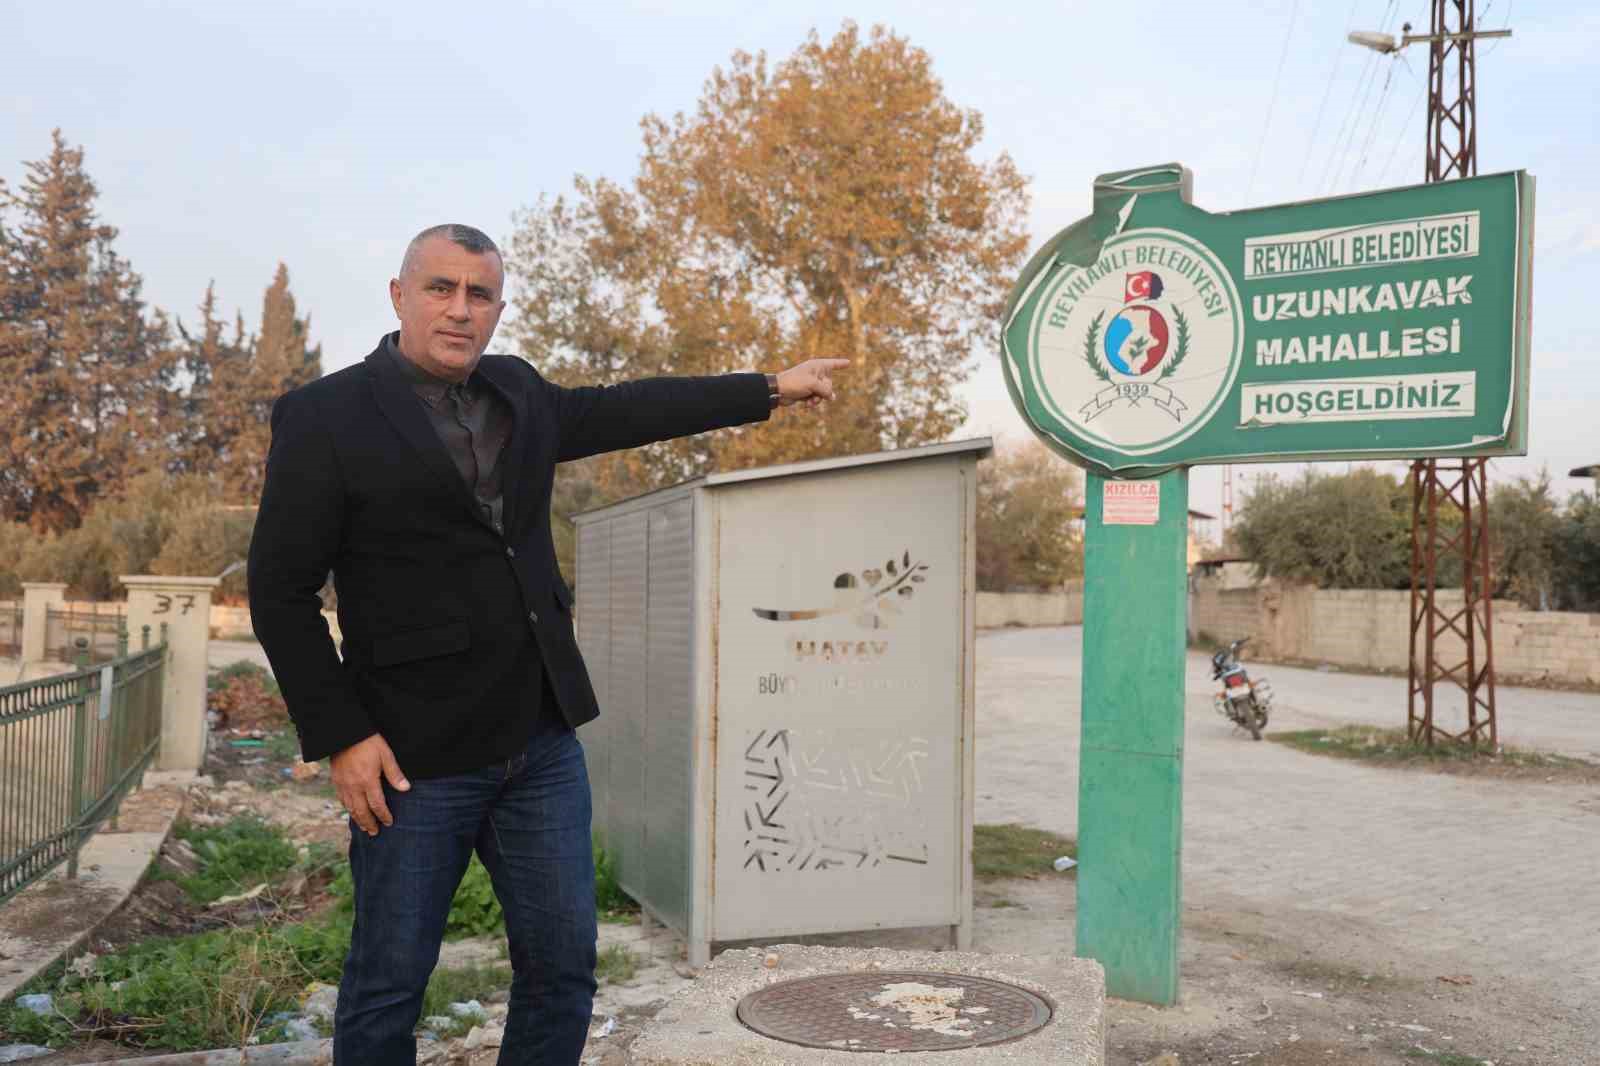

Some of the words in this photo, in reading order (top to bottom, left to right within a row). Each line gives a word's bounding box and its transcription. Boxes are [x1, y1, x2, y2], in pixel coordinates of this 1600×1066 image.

[1253, 237, 1346, 275] REYHANLI
[1352, 215, 1469, 264] BELEDİYESİ
[1135, 245, 1229, 318] BELEDİYESİ
[1252, 274, 1473, 322] UZUNKAVAK
[1255, 317, 1461, 366] MAHALLESİ
[1116, 384, 1150, 398] 1939
[1254, 379, 1461, 418] HOŞGELDİNİZ
[152, 593, 195, 616] 37
